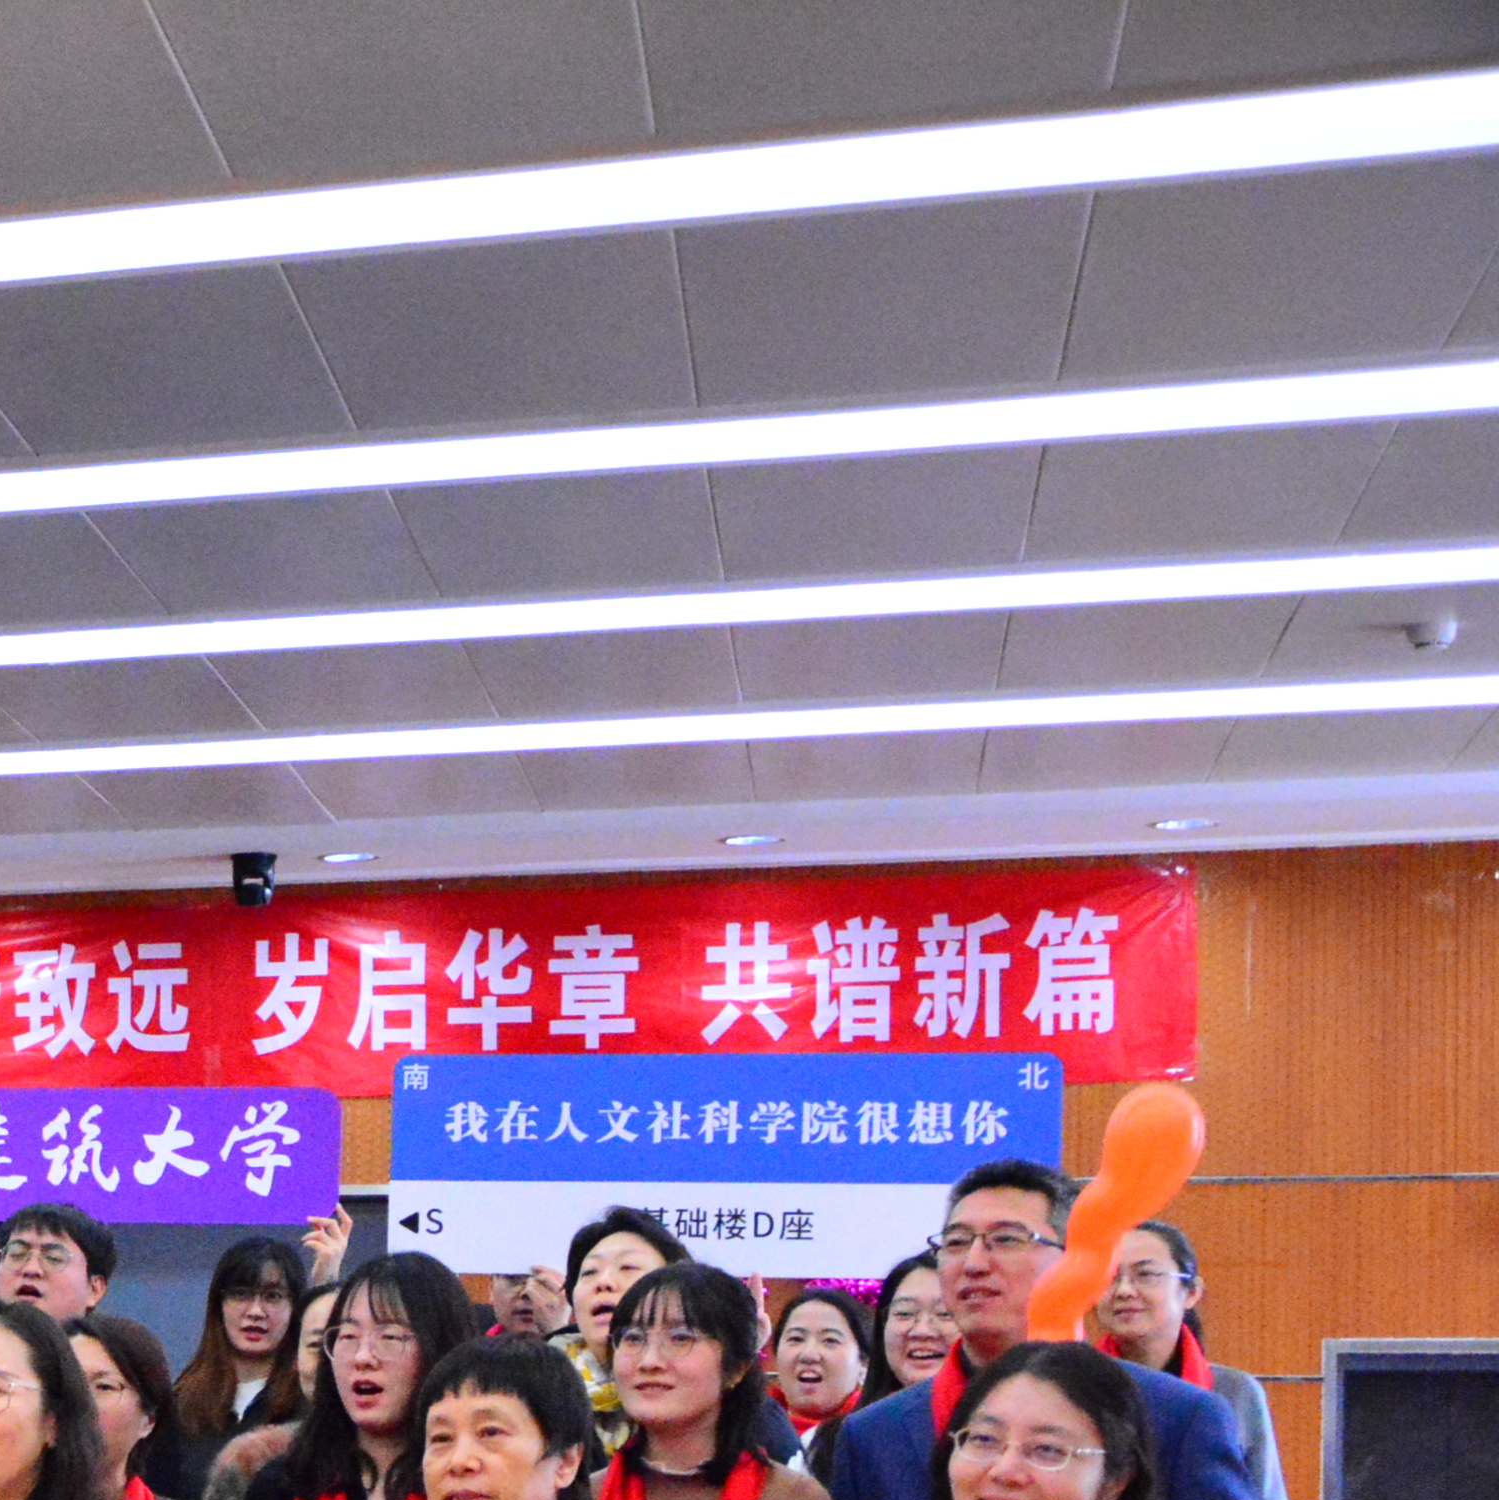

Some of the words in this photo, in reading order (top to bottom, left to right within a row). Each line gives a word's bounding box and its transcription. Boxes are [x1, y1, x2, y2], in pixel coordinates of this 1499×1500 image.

[252, 923, 640, 1056] 岁启华章
[700, 906, 1120, 1048] 共谱新篇
[402, 1062, 430, 1092] 南
[1017, 1062, 1050, 1092] 北
[444, 1098, 1011, 1146] 我在人文社科学院很想你
[424, 1206, 444, 1236] S
